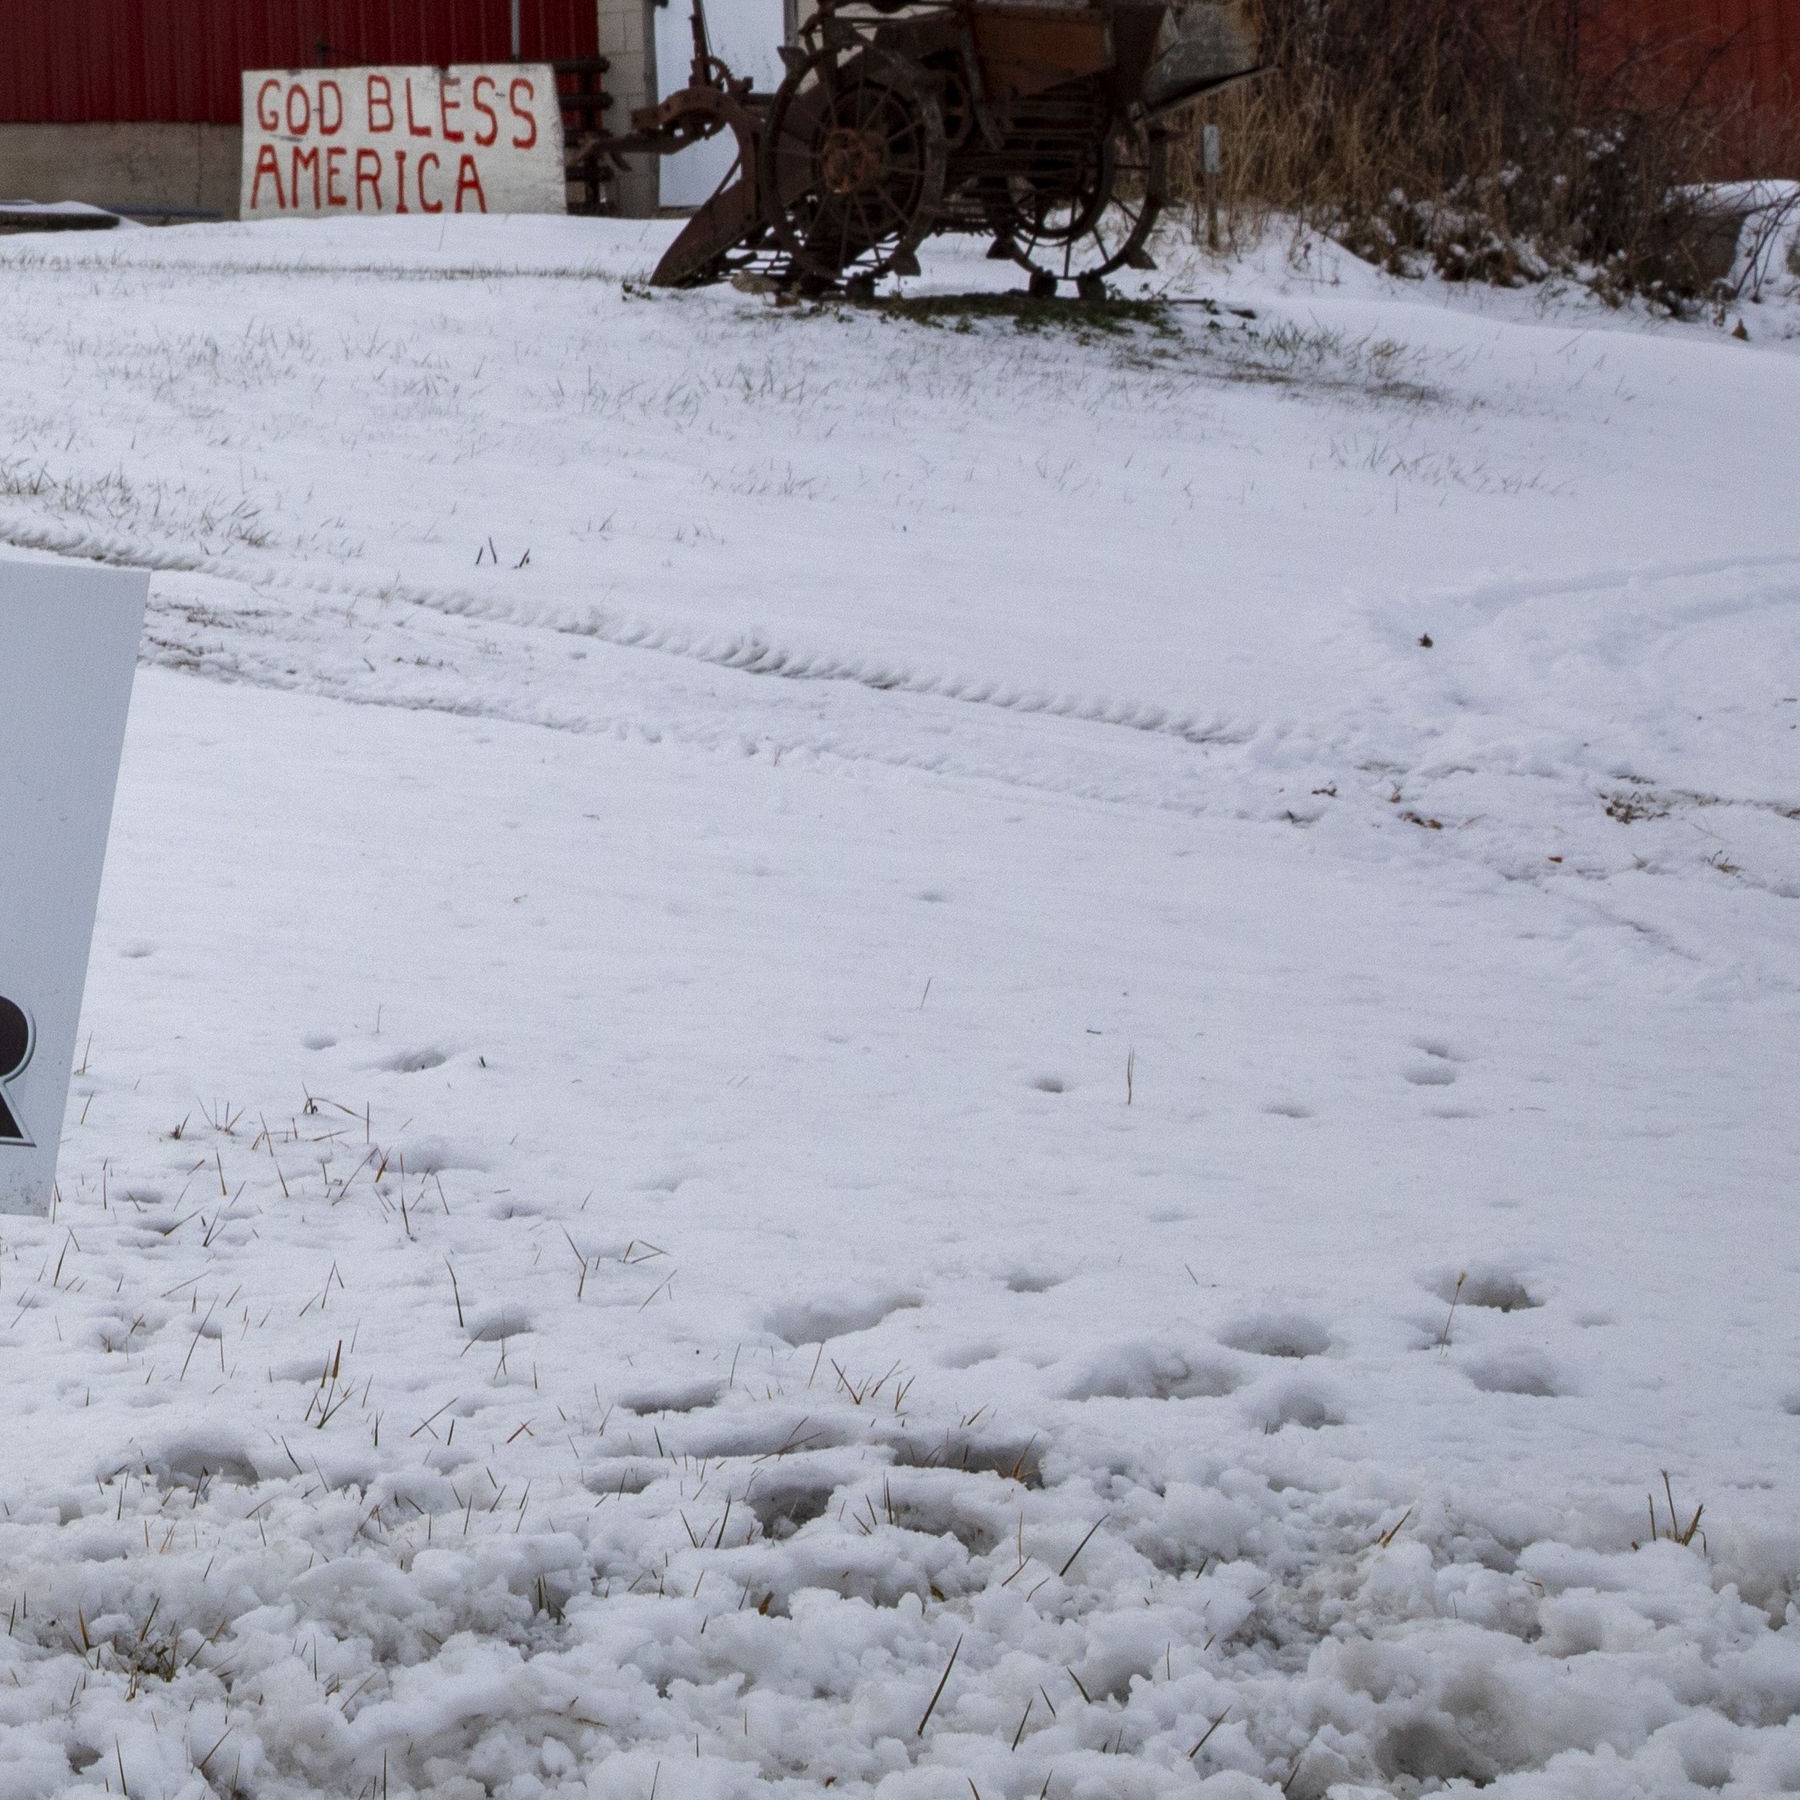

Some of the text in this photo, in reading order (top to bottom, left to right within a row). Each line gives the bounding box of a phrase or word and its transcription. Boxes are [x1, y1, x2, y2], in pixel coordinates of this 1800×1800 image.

[257, 75, 537, 149] GOD BLESS
[251, 144, 487, 214] AMERICA
